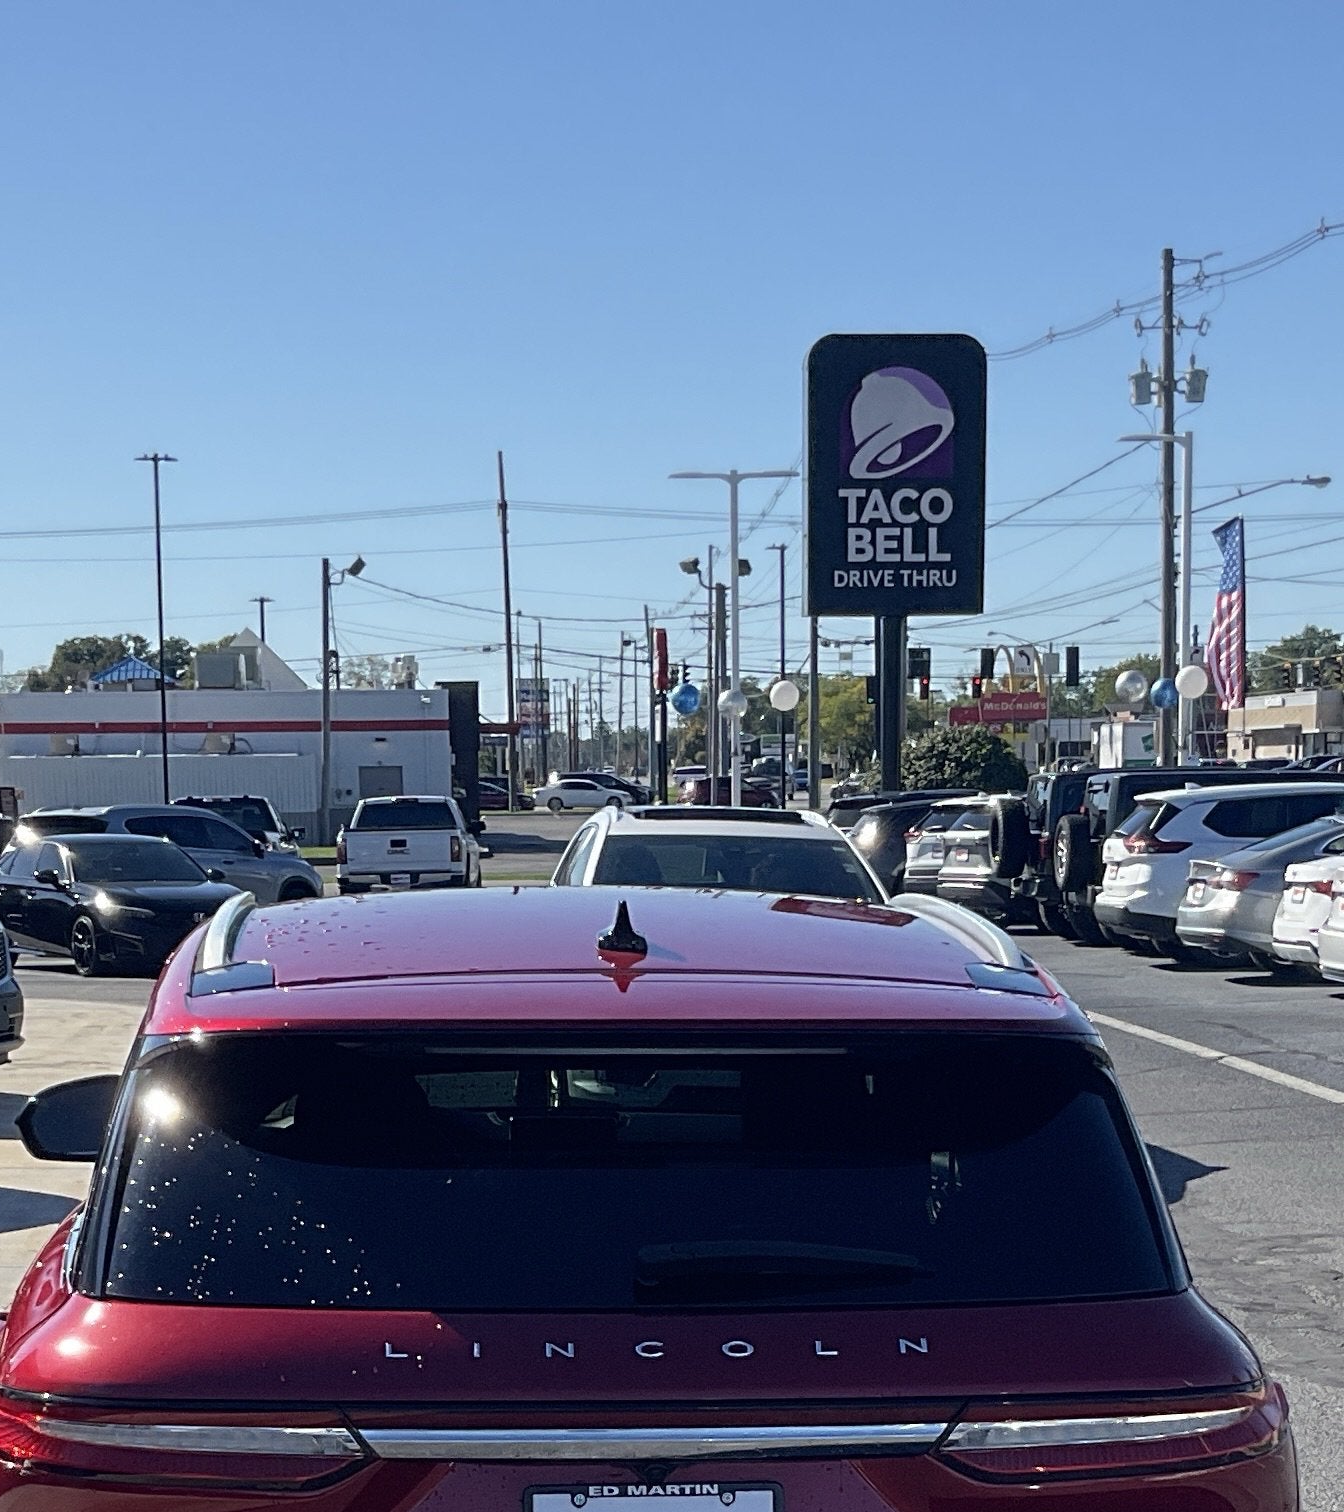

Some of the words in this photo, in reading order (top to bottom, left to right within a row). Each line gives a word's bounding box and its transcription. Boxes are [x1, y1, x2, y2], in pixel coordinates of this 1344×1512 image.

[837, 488, 954, 524] TACO
[847, 527, 952, 563] BELL
[833, 570, 895, 588] DRIVE
[899, 569, 957, 587] THRU
[983, 702, 1047, 712] McDonald's
[385, 1337, 929, 1359] LINCOLN
[588, 1485, 620, 1497] ED
[627, 1483, 719, 1496] MARTIN
